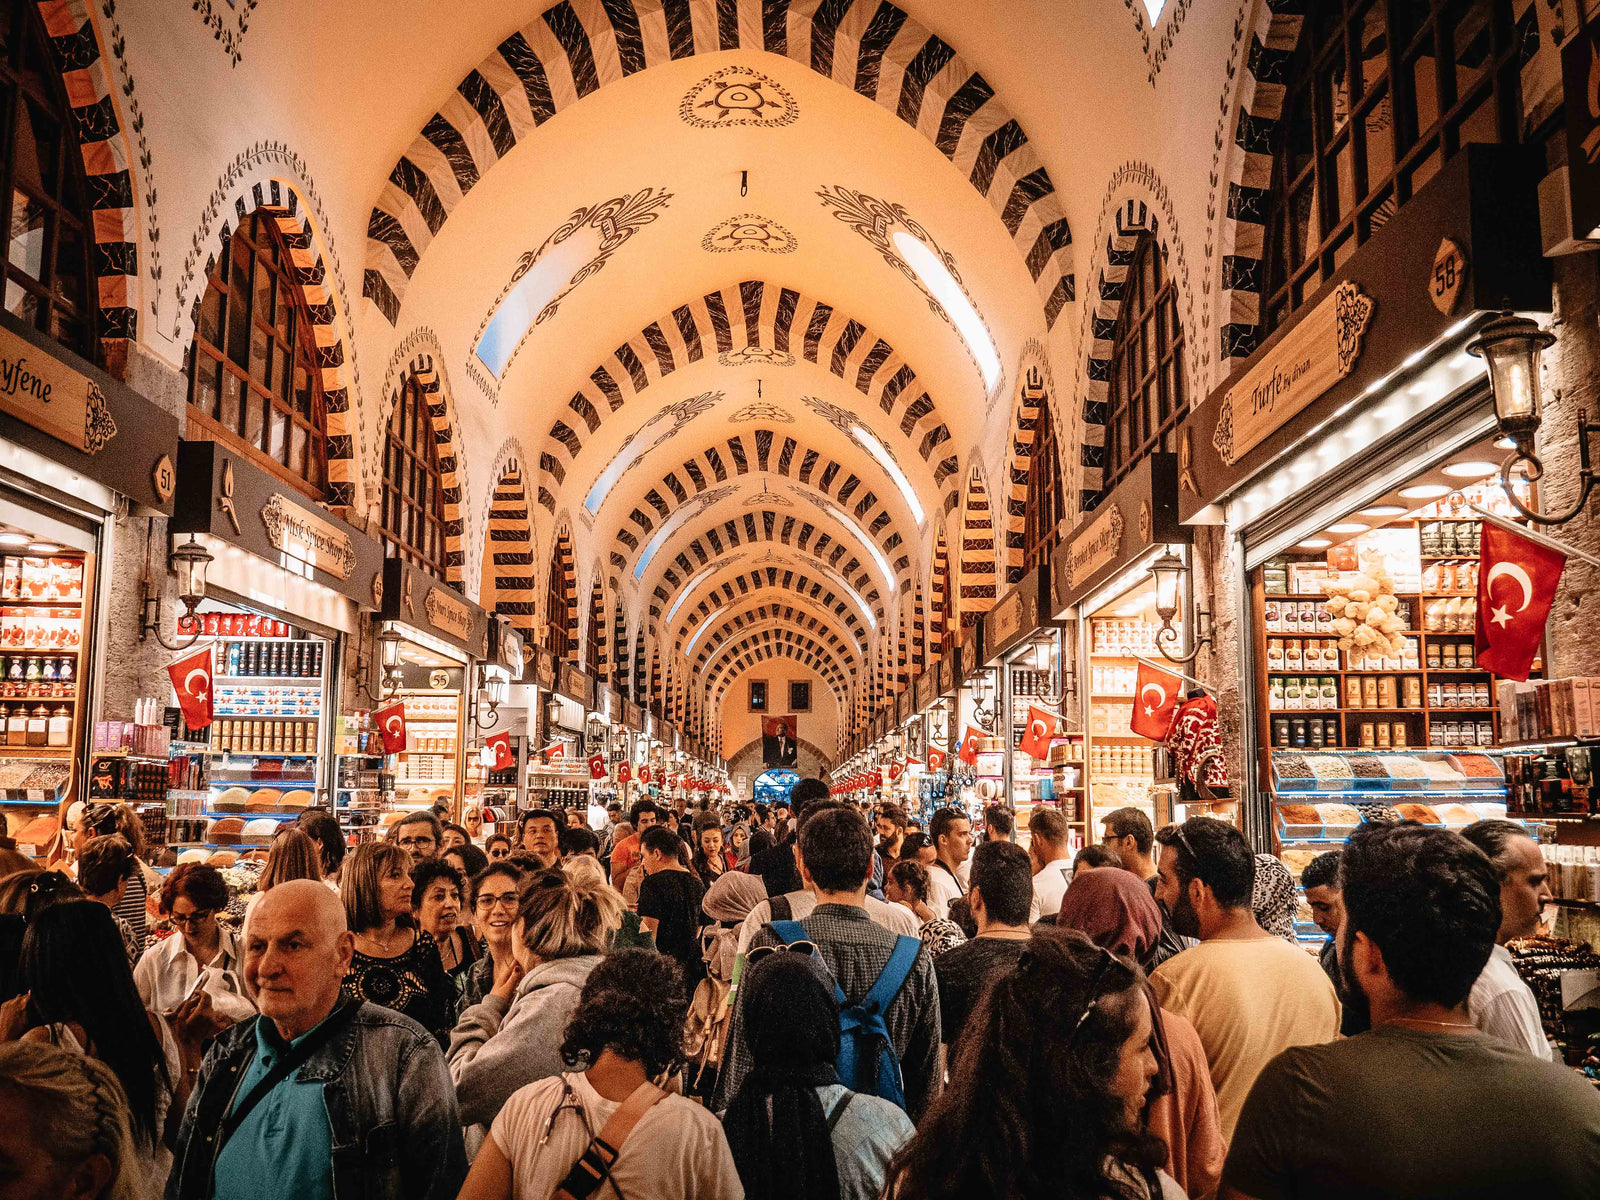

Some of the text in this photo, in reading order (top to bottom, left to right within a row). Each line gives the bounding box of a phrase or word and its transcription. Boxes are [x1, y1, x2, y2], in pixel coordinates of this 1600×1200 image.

[1436, 255, 1455, 297] 58
[1251, 365, 1282, 416] Turfe
[161, 469, 171, 491] 51
[282, 513, 344, 566] Misk Spice Shop
[433, 674, 447, 687] 55
